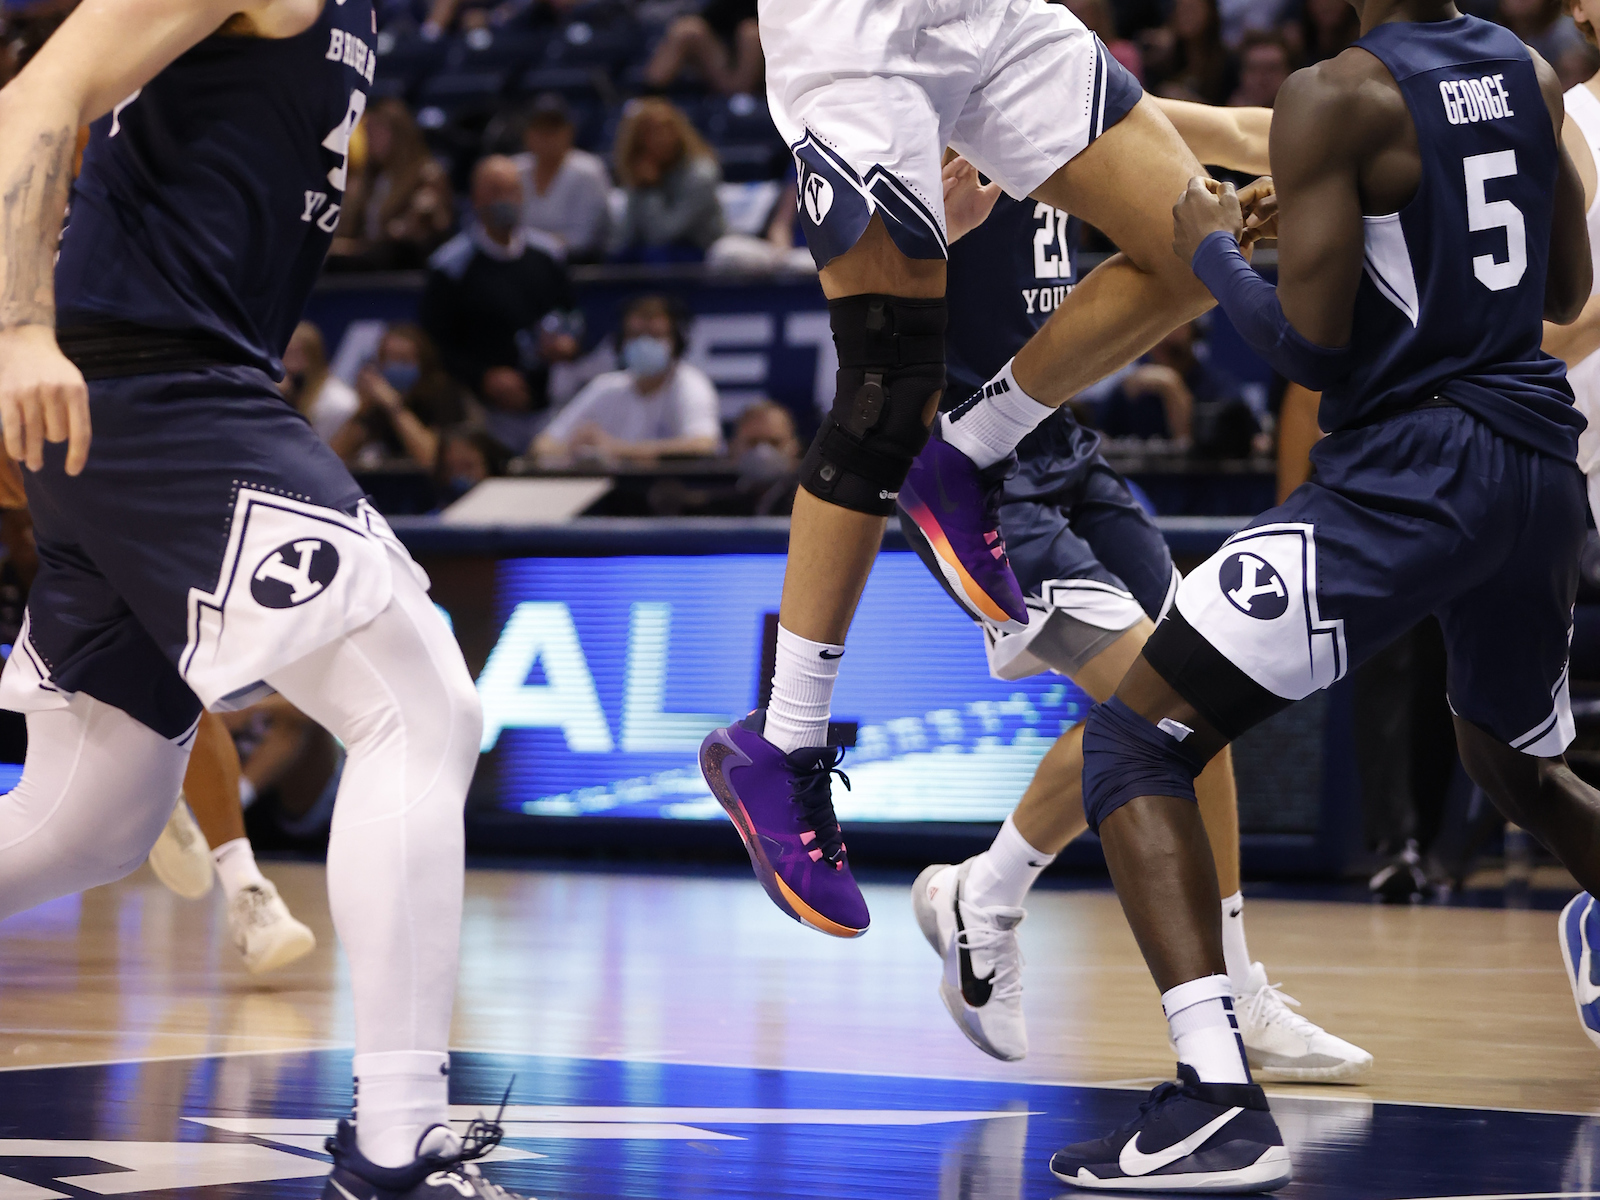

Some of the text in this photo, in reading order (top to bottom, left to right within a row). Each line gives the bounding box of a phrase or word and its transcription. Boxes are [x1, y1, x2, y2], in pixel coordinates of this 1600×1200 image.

[1439, 73, 1514, 125] GEORGE
[1033, 201, 1071, 279] 21
[1463, 149, 1527, 291] 5
